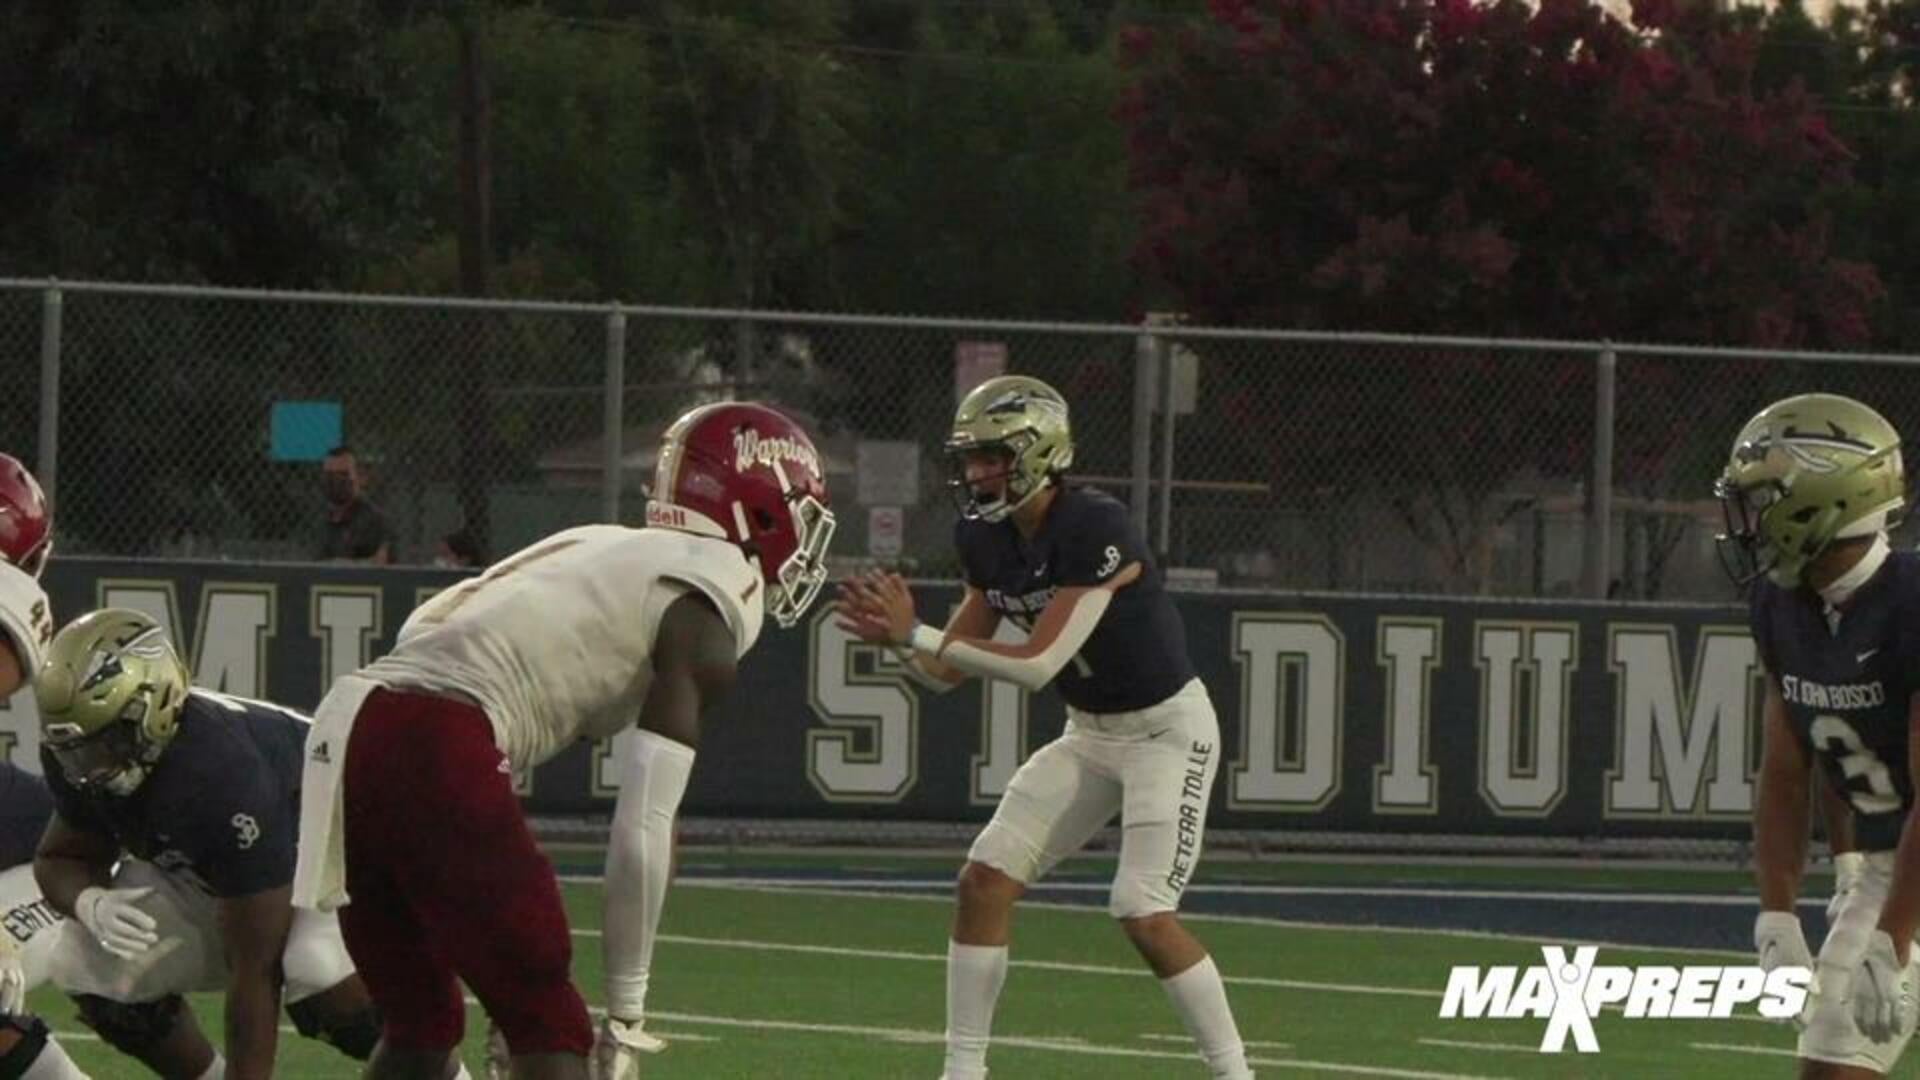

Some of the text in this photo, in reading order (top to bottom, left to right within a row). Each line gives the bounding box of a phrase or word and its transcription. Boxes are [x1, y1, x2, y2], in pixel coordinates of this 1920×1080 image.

[806, 600, 1765, 819] SDIUM
[1828, 680, 1886, 710] BOSCO
[1182, 740, 1212, 801] TOLLE
[1809, 714, 1903, 815] 3
